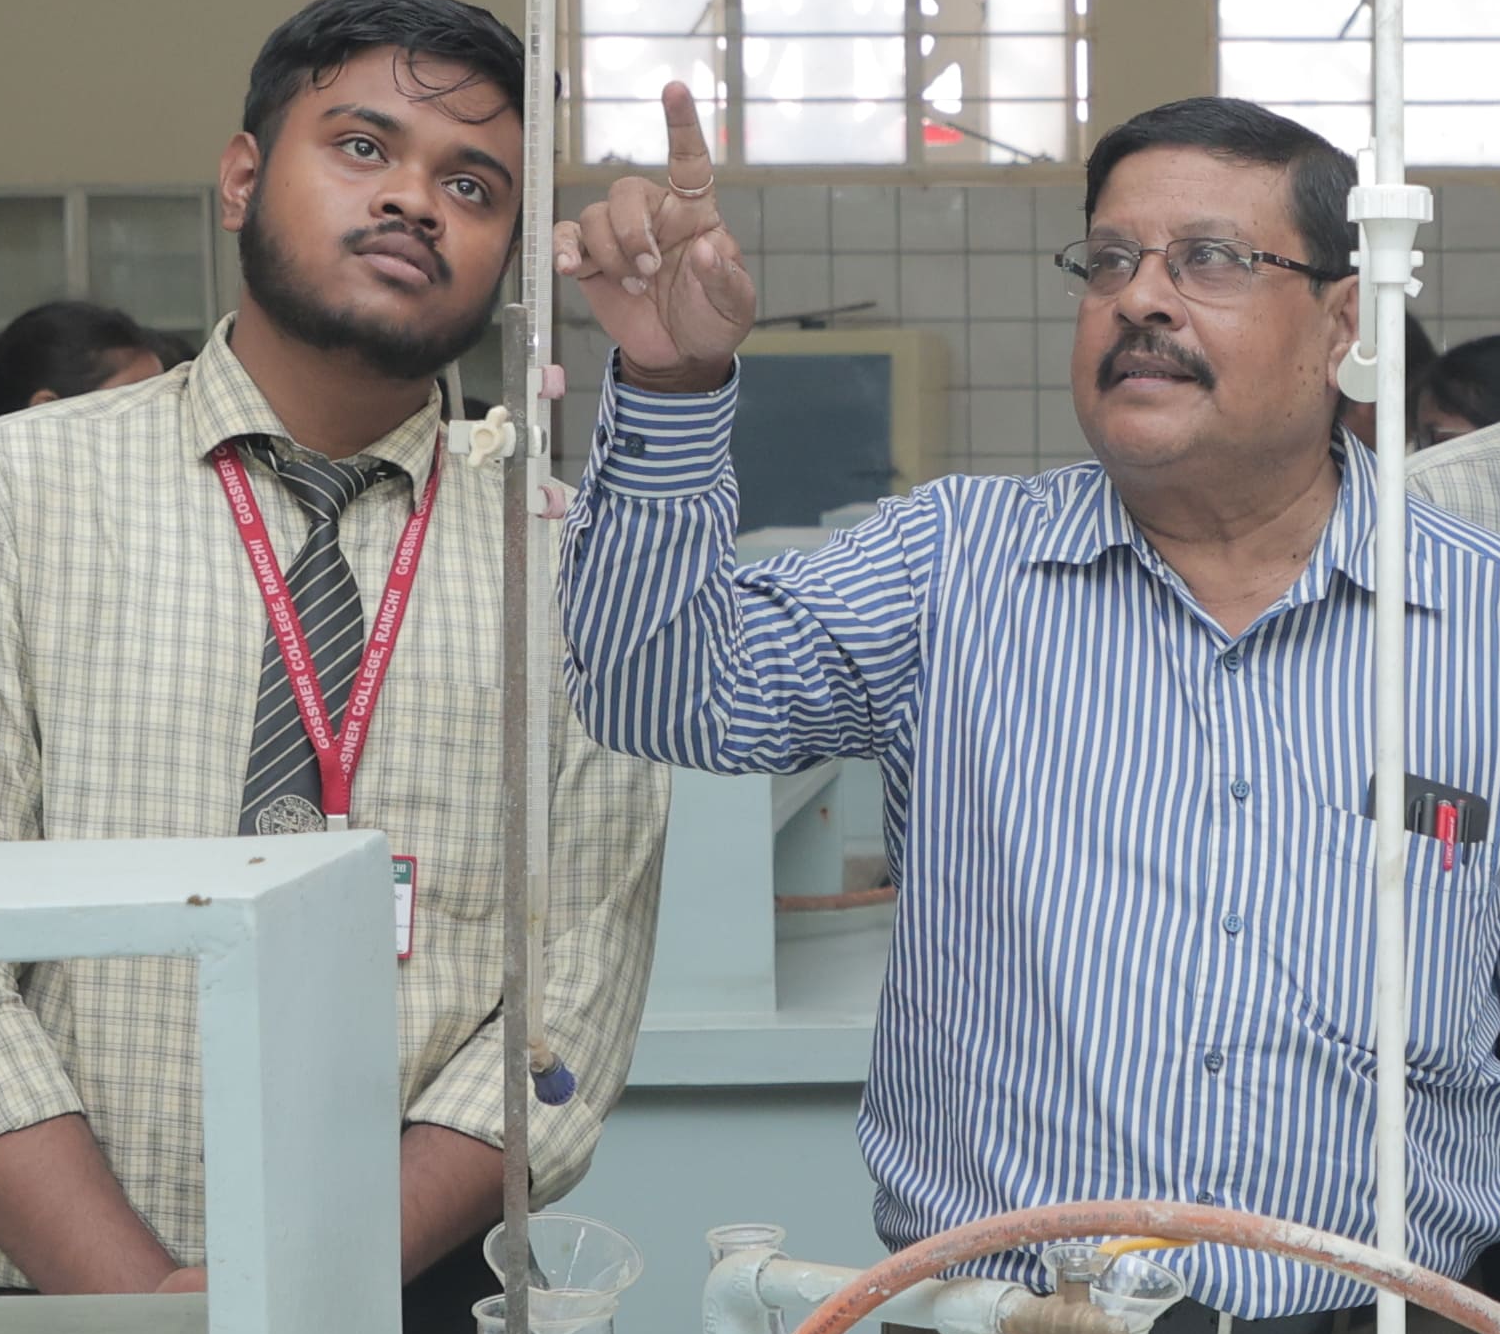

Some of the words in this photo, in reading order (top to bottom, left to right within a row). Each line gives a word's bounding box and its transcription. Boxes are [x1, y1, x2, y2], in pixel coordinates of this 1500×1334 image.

[220, 458, 254, 525] GOSSNER
[249, 539, 281, 597] RANCHI
[396, 515, 423, 576] GOSSNER
[272, 596, 303, 671] COLLEGE,
[297, 675, 330, 750] GOSSNER
[342, 719, 361, 781] SSNER
[352, 645, 387, 718] COLLEGE,
[375, 588, 401, 643] RANCHI
